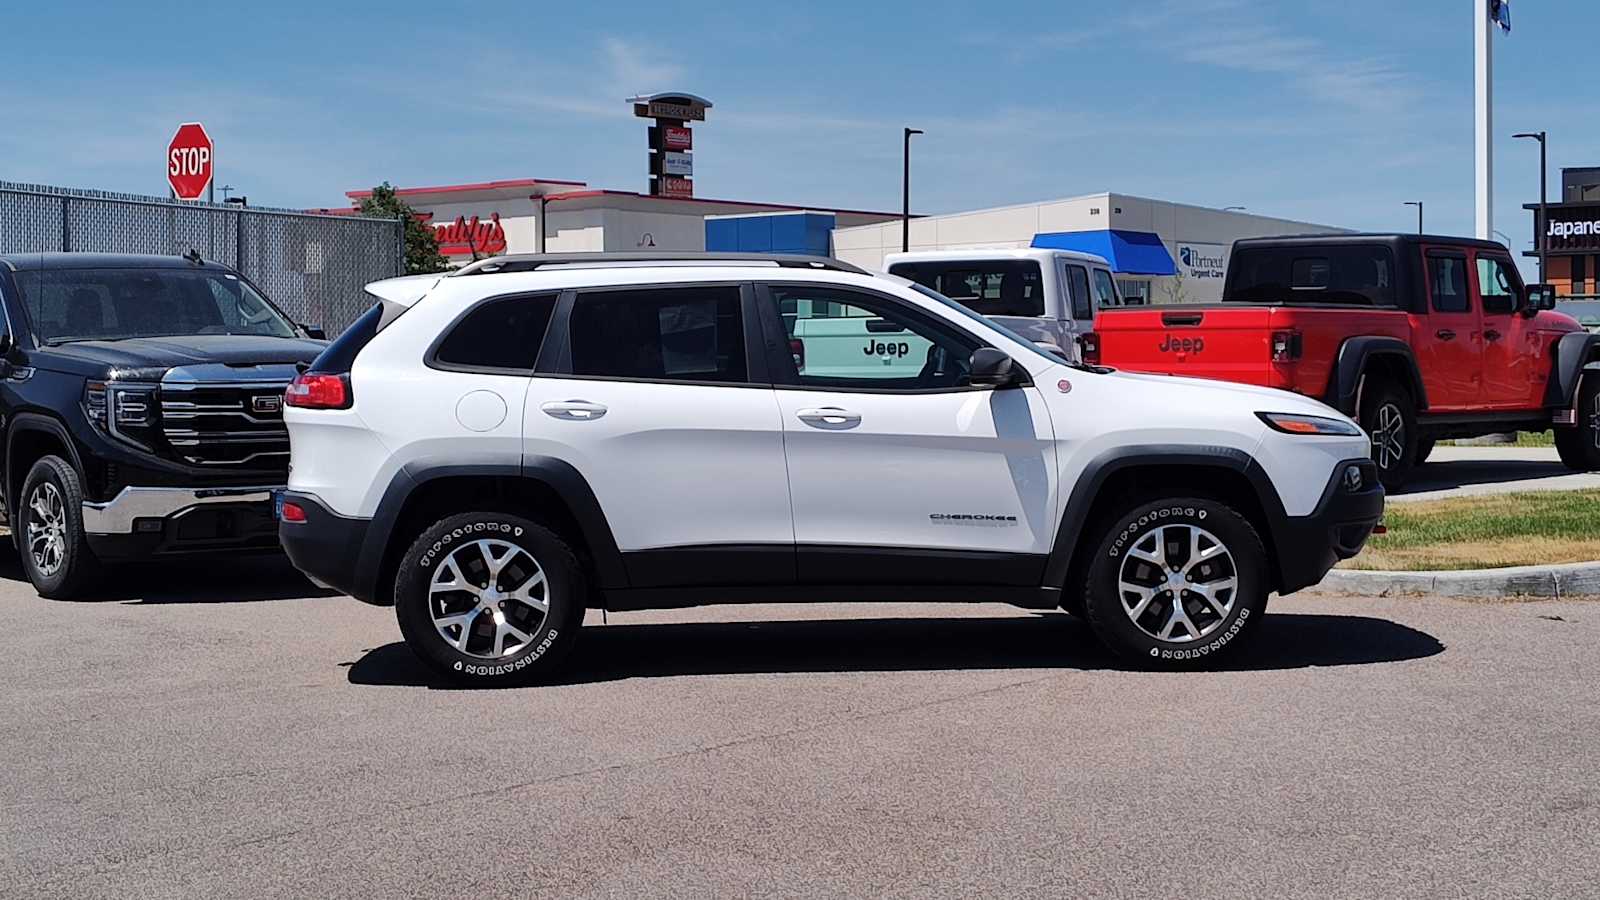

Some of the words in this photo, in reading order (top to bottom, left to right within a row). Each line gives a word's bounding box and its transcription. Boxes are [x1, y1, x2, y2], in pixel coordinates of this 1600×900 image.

[170, 147, 209, 176] STOP
[1547, 219, 1600, 239] Japane
[1191, 249, 1224, 267] Portneuf
[1191, 269, 1210, 278] Urgent
[1211, 270, 1224, 278] Care
[863, 339, 909, 358] Jeep
[1159, 334, 1204, 355] Jeep
[929, 513, 1017, 521] CHEROKEE
